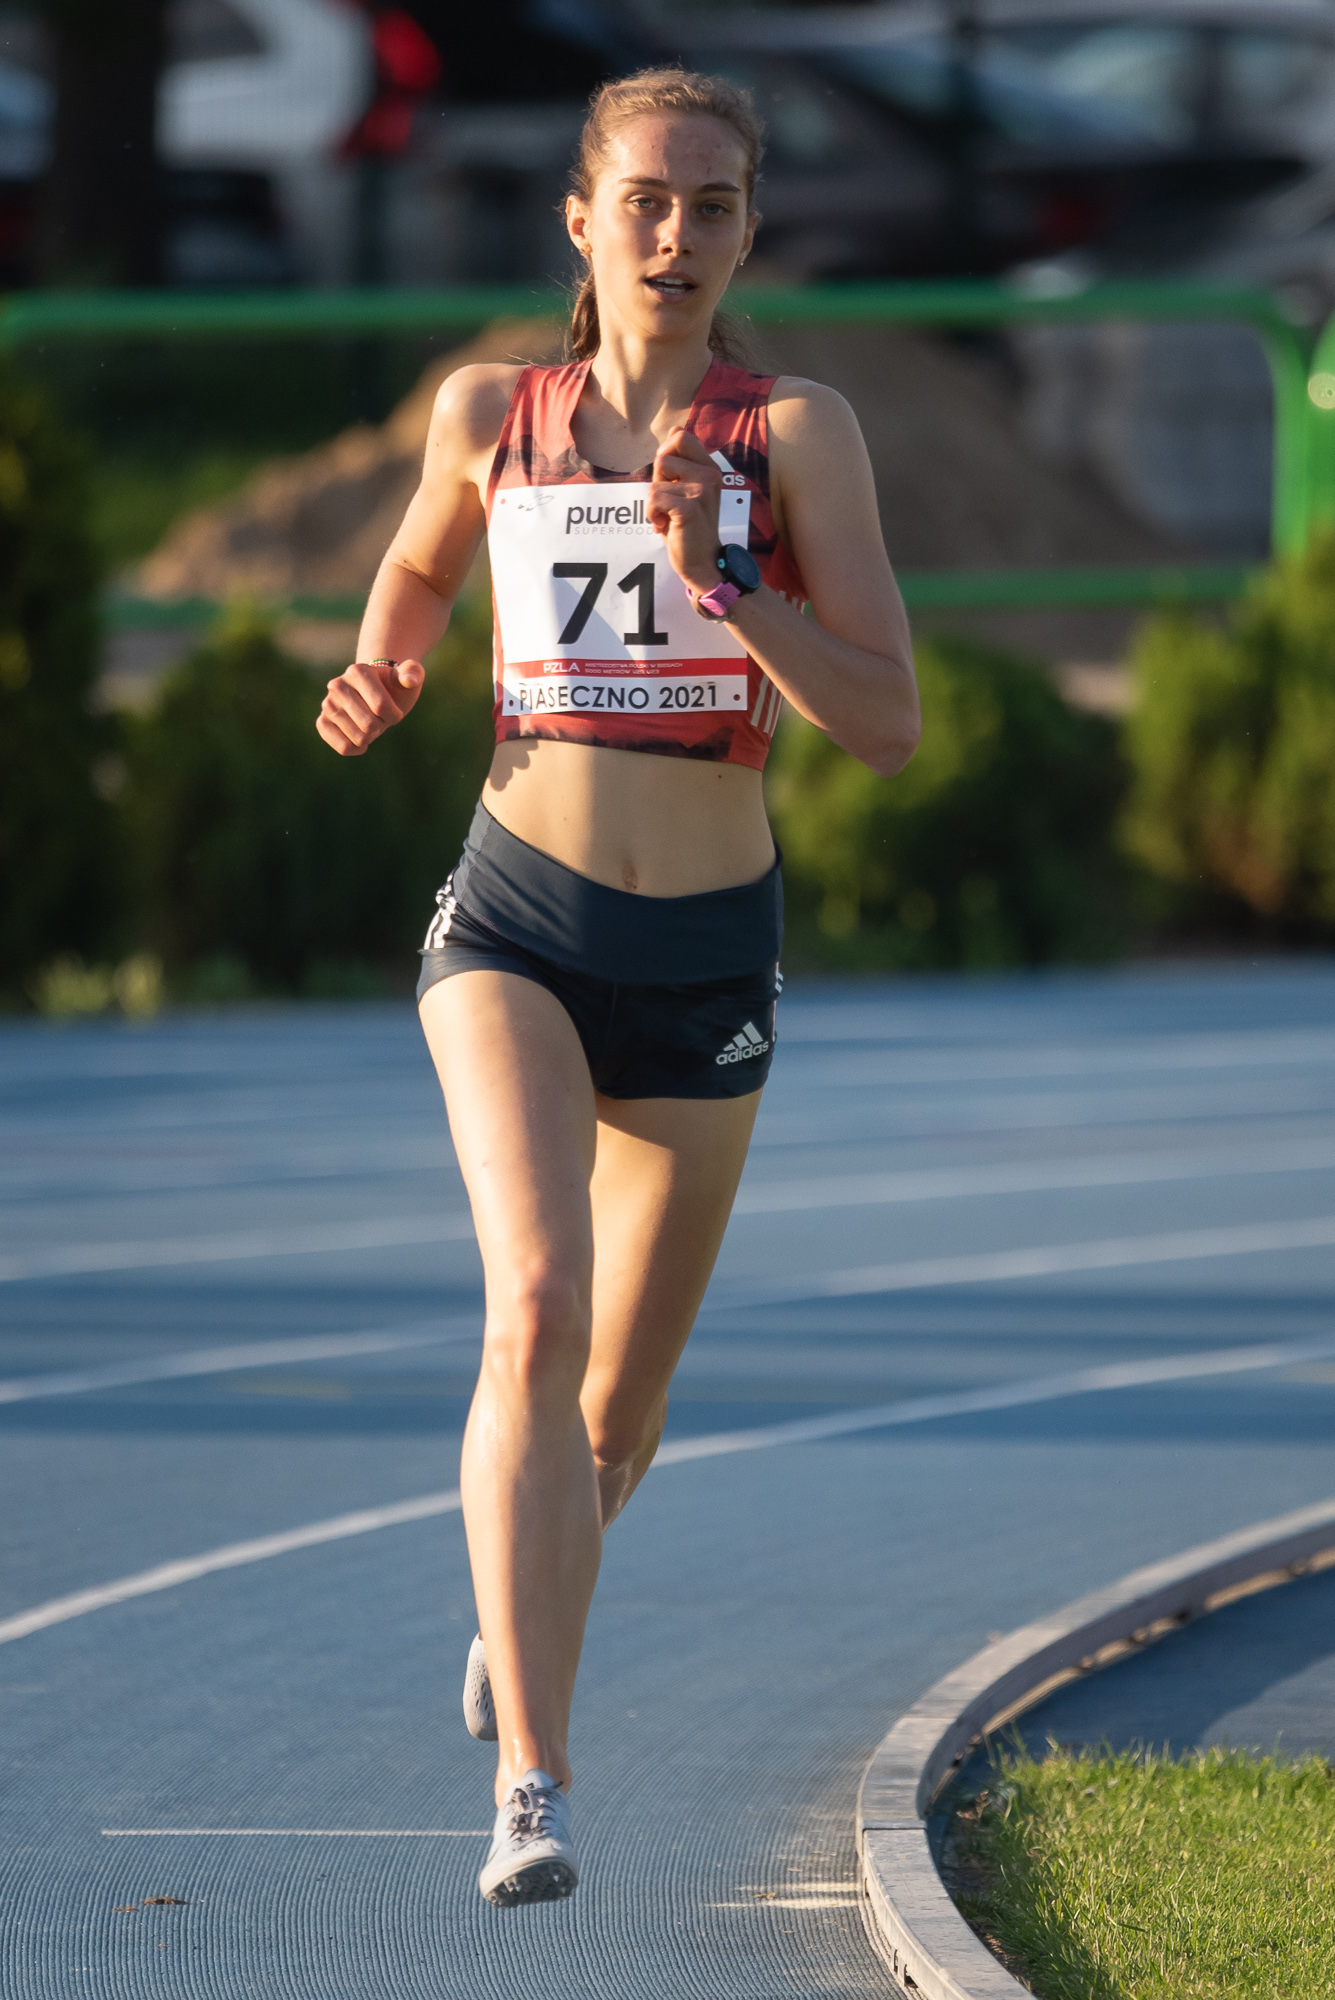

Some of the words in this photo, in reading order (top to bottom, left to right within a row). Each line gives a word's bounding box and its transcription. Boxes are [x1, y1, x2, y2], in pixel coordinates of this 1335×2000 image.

[566, 499, 653, 535] purell
[552, 562, 669, 646] 71
[543, 662, 580, 675] PZLA
[519, 685, 649, 711] PIASECZNO
[658, 685, 717, 709] 2021
[715, 1041, 769, 1066] adidas
